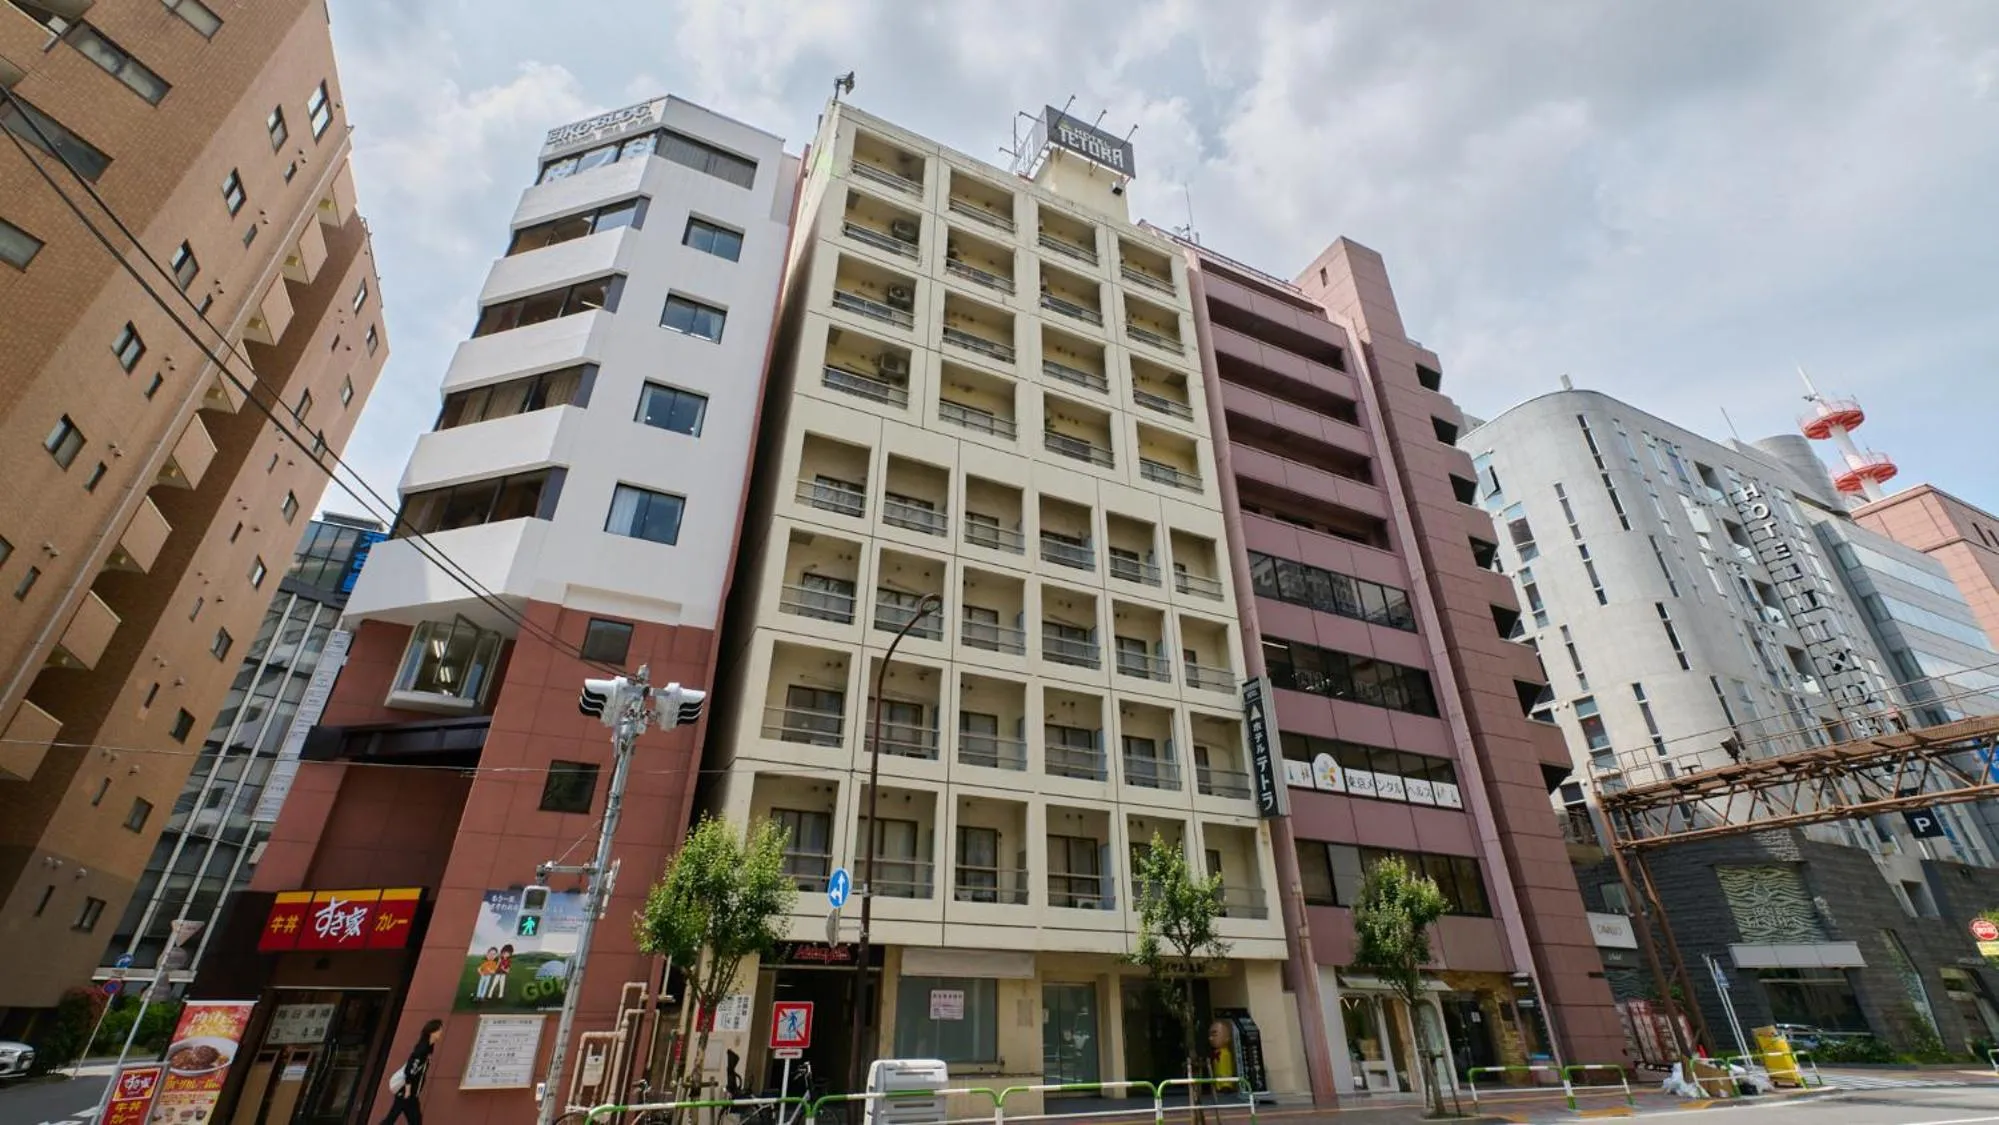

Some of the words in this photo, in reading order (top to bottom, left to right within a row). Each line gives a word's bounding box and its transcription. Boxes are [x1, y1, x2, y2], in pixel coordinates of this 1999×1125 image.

[1058, 126, 1124, 169] TETORA
[1252, 721, 1274, 811] ホテルテトラ
[1914, 817, 1931, 833] P
[271, 914, 300, 934] 牛丼
[315, 896, 369, 943] すき家
[375, 911, 408, 932] カレー
